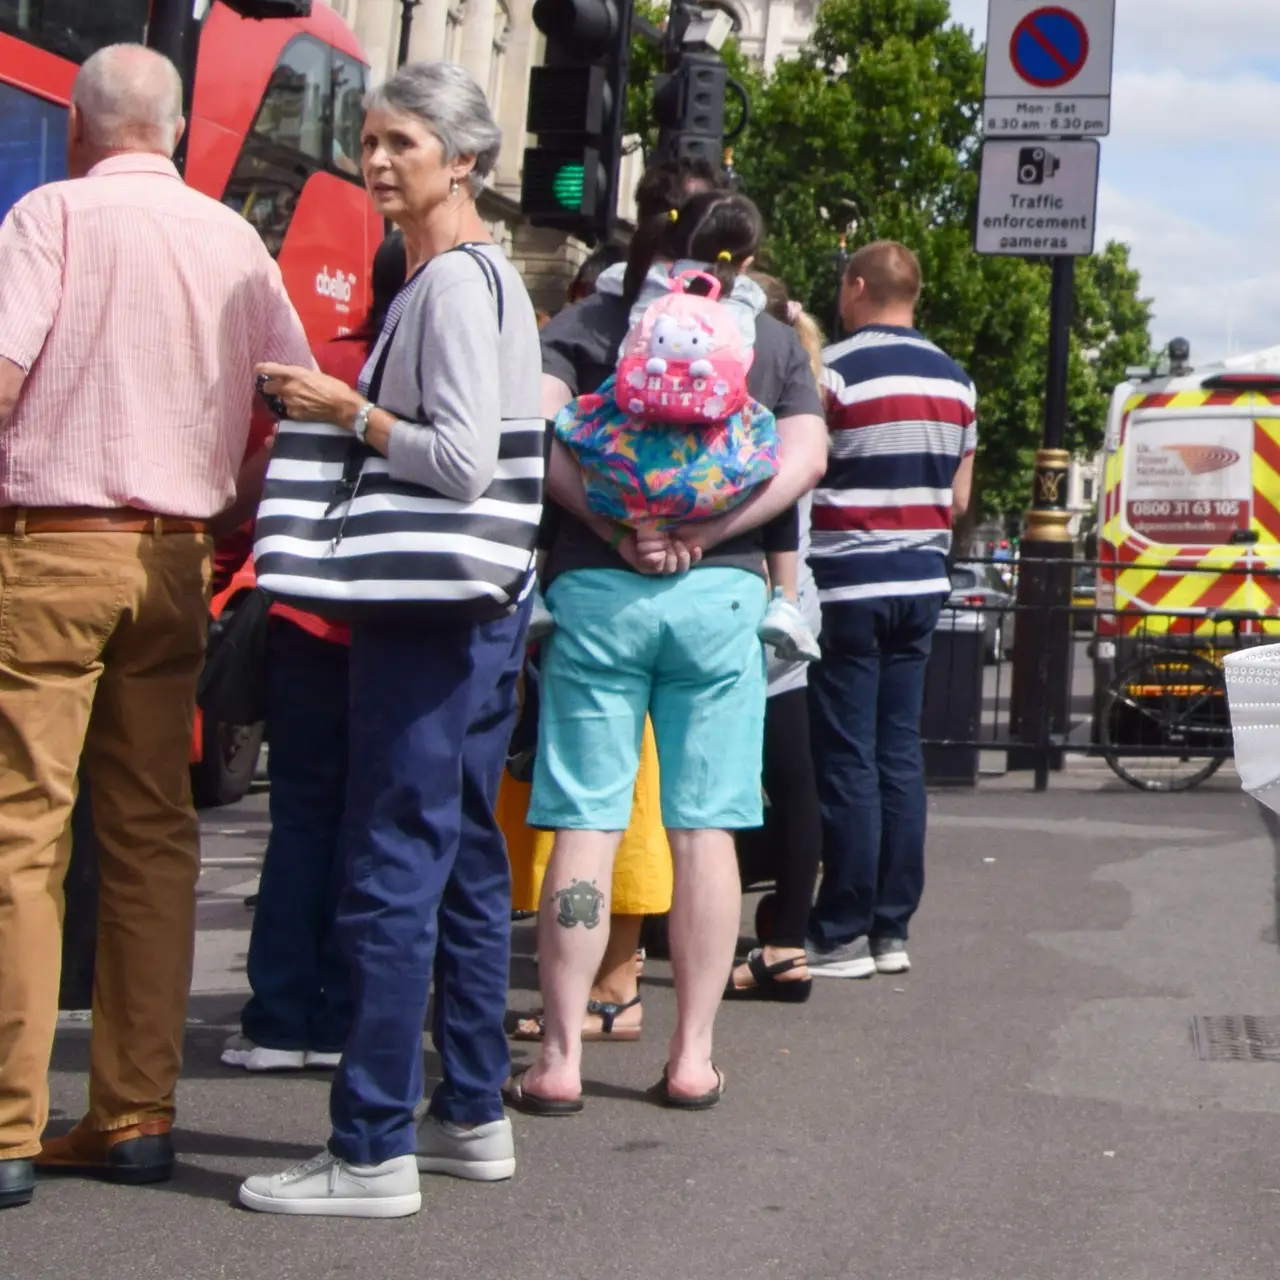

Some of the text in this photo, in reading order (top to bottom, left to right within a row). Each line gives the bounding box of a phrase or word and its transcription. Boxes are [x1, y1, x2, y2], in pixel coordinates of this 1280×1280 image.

[1016, 102, 1044, 114] Mon
[1054, 102, 1077, 114] Sat
[1021, 121, 1040, 130] am
[1084, 120, 1104, 131] pm
[1010, 193, 1064, 210] Traffic
[983, 213, 1087, 229] enforcement
[1132, 500, 1239, 516] 0800 31 63 105
